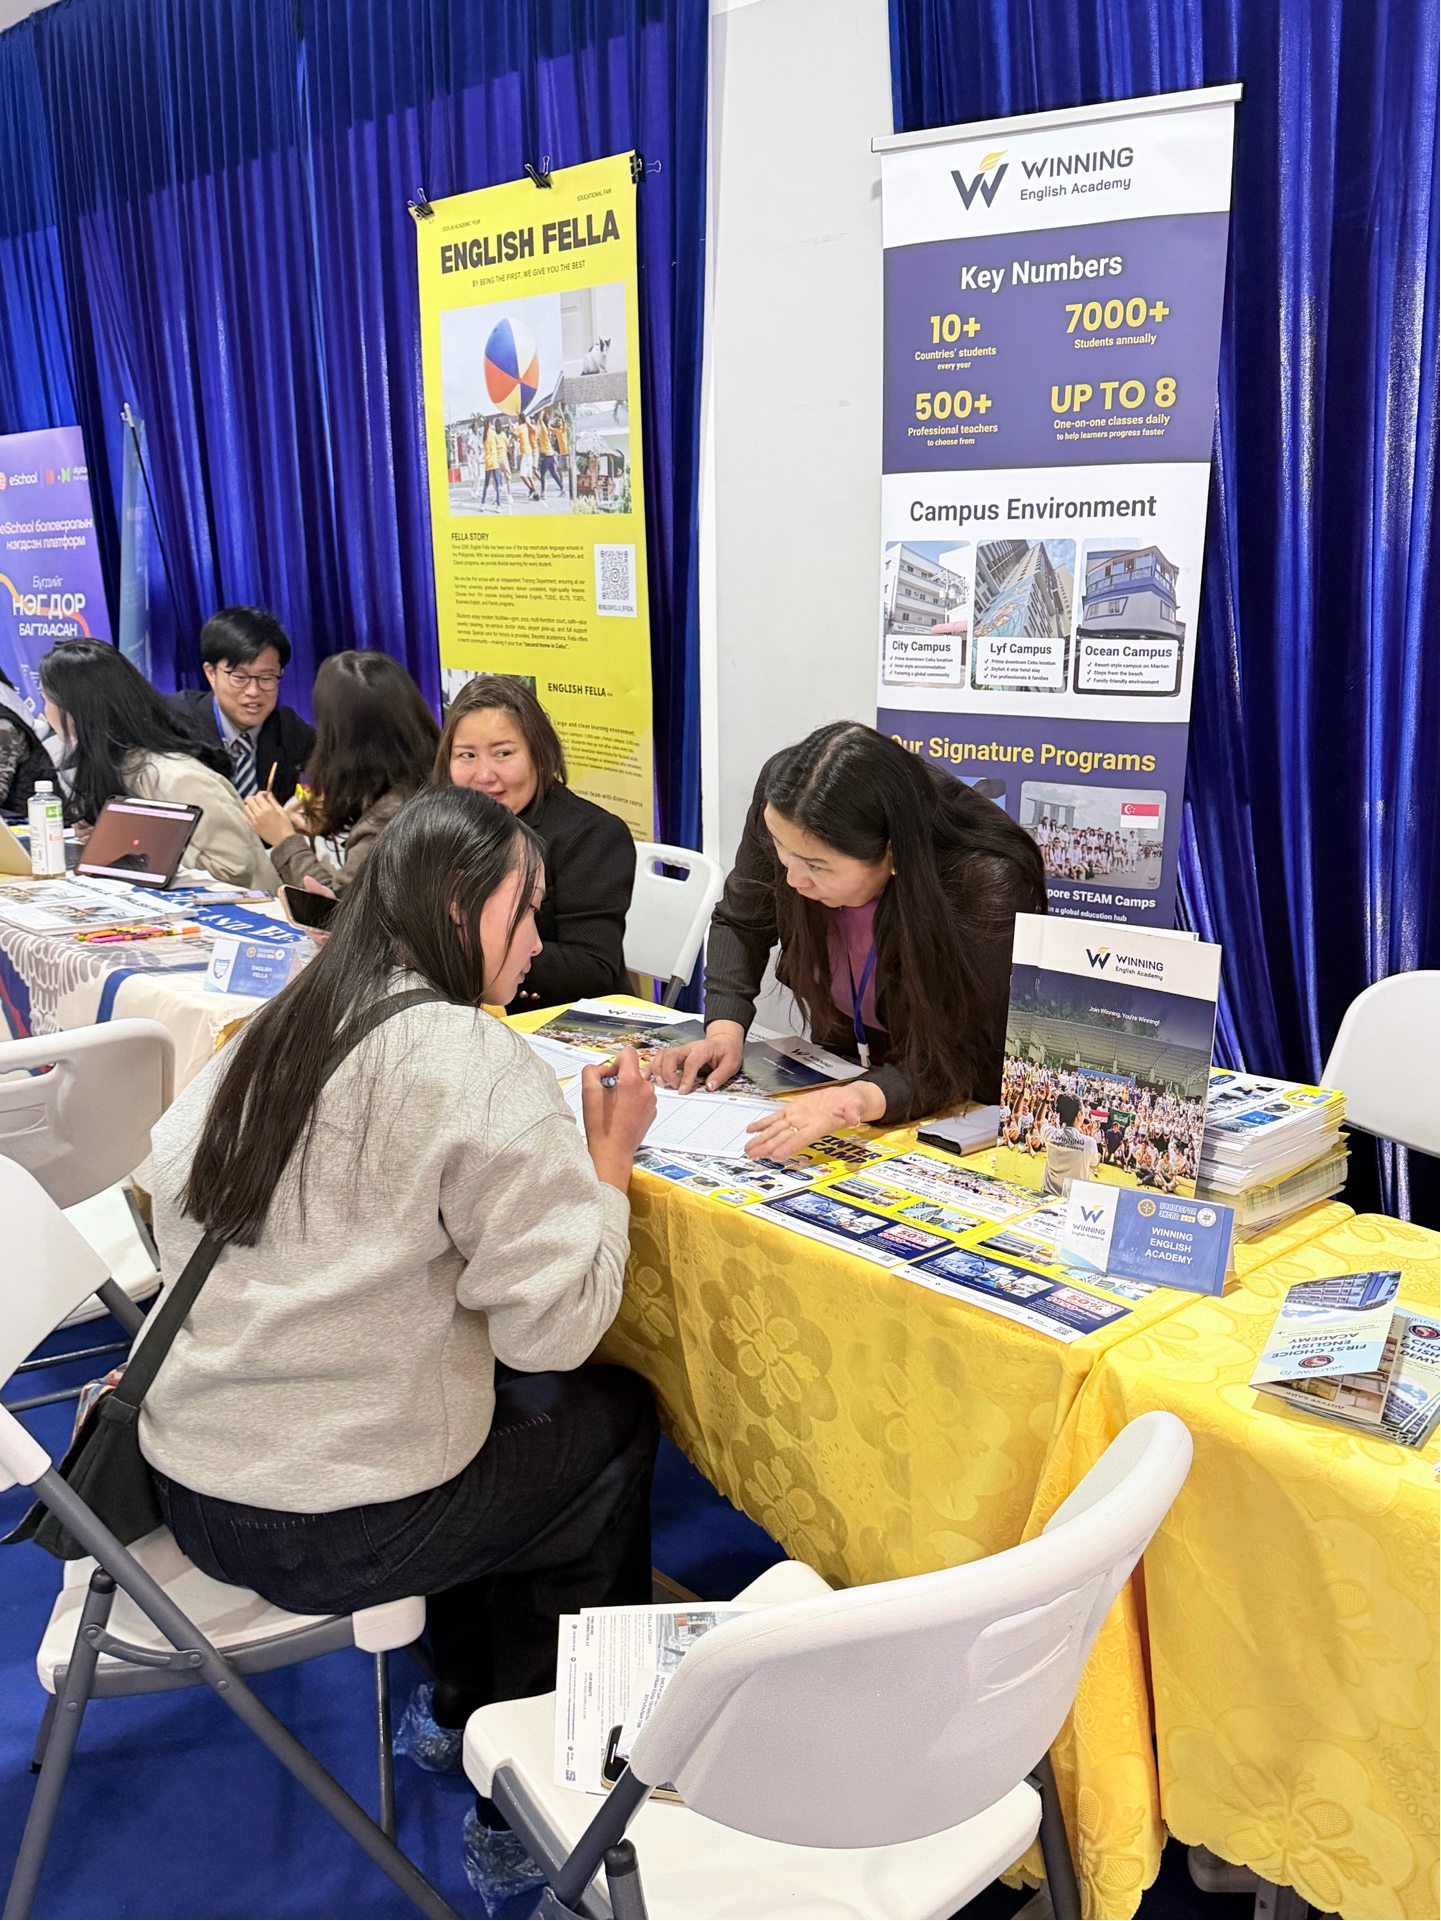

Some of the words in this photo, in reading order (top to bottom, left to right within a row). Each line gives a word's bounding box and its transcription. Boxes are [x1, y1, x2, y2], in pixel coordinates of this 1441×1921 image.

[1021, 147, 1134, 180] WINNING
[1020, 184, 1067, 201] English
[1071, 177, 1132, 195] Academy
[440, 226, 534, 274] ENGLISH
[542, 209, 620, 255] FELLA
[472, 280, 479, 288] BY
[479, 277, 495, 287] BEING
[495, 275, 505, 284] THE
[506, 271, 522, 283] FIRST,
[523, 270, 533, 279] WE
[533, 267, 546, 277] GIVE
[547, 265, 560, 274] YOU
[560, 263, 571, 272] THE
[571, 259, 586, 271] BEST
[960, 265, 1005, 293] Key
[1012, 254, 1123, 285] Numbers
[1065, 297, 1169, 333] 7000+
[930, 314, 981, 344] 10+
[1074, 335, 1114, 349] Students
[1115, 333, 1157, 348] annually
[959, 345, 997, 358] students
[956, 361, 971, 370] year
[1051, 383, 1092, 413] UP
[1100, 380, 1145, 410] TO
[1155, 377, 1177, 407] 8
[915, 390, 991, 420] 500+
[908, 425, 958, 436] Professional
[960, 423, 998, 434] teachers
[1054, 418, 1106, 429] One-on-one
[1108, 416, 1144, 427] classes
[1146, 414, 1170, 426] daily
[935, 438, 958, 446] choose
[1064, 432, 1079, 442] help
[1080, 431, 1108, 440] learners
[1109, 430, 1141, 440] progress
[1142, 428, 1165, 437] faster
[9, 472, 38, 486] eSchool
[909, 500, 999, 526] Campus
[1006, 495, 1157, 520] Environment
[0, 521, 35, 535] eSchool
[35, 517, 93, 532] боловсролын
[6, 539, 42, 551] нэгдсэн
[43, 535, 86, 550] платформ
[451, 533, 469, 541] FELLA
[469, 533, 489, 541] STORY
[19, 623, 78, 637] БАГТААСАН
[892, 640, 909, 654] City
[910, 641, 951, 655] Campus
[990, 643, 1007, 656] Lyf
[1009, 644, 1052, 658] Campus
[1085, 646, 1121, 657] Ocean
[1122, 647, 1173, 659] Campus
[548, 682, 583, 694] ENGLISH
[584, 686, 607, 698] FELLA
[568, 721, 578, 729] and
[578, 722, 590, 730] clean
[590, 723, 609, 733] learning
[928, 737, 1034, 764] Signature
[1040, 744, 1156, 773] Programs
[589, 791, 601, 799] team
[601, 793, 612, 801] with
[612, 795, 629, 805] diverse
[629, 799, 643, 808] course
[1072, 890, 1113, 905] STEAM
[1114, 895, 1156, 909] Camps
[1060, 906, 1080, 916] global
[1080, 908, 1112, 920] education
[1113, 912, 1128, 922] hub
[1115, 953, 1164, 972] WINNING
[1115, 965, 1136, 977] English
[1136, 970, 1164, 981] Academy
[1138, 1015, 1160, 1027] Winning!
[808, 1142, 867, 1165] CAMP
[821, 1135, 882, 1160] INTER
[897, 1229, 929, 1244] 50%
[1072, 1223, 1106, 1236] WINNING
[1151, 1226, 1193, 1242] WINNING
[1149, 1238, 1192, 1253] ENGLISH
[1144, 1249, 1193, 1265] ACADEMY
[1066, 1294, 1104, 1312] 50%
[1288, 1333, 1359, 1344] ACADEMY
[1291, 1340, 1351, 1349] ENGLISH
[1271, 1348, 1323, 1358] CHOICE
[1328, 1343, 1367, 1352] FIRST
[1294, 1365, 1344, 1375] WELCOME
